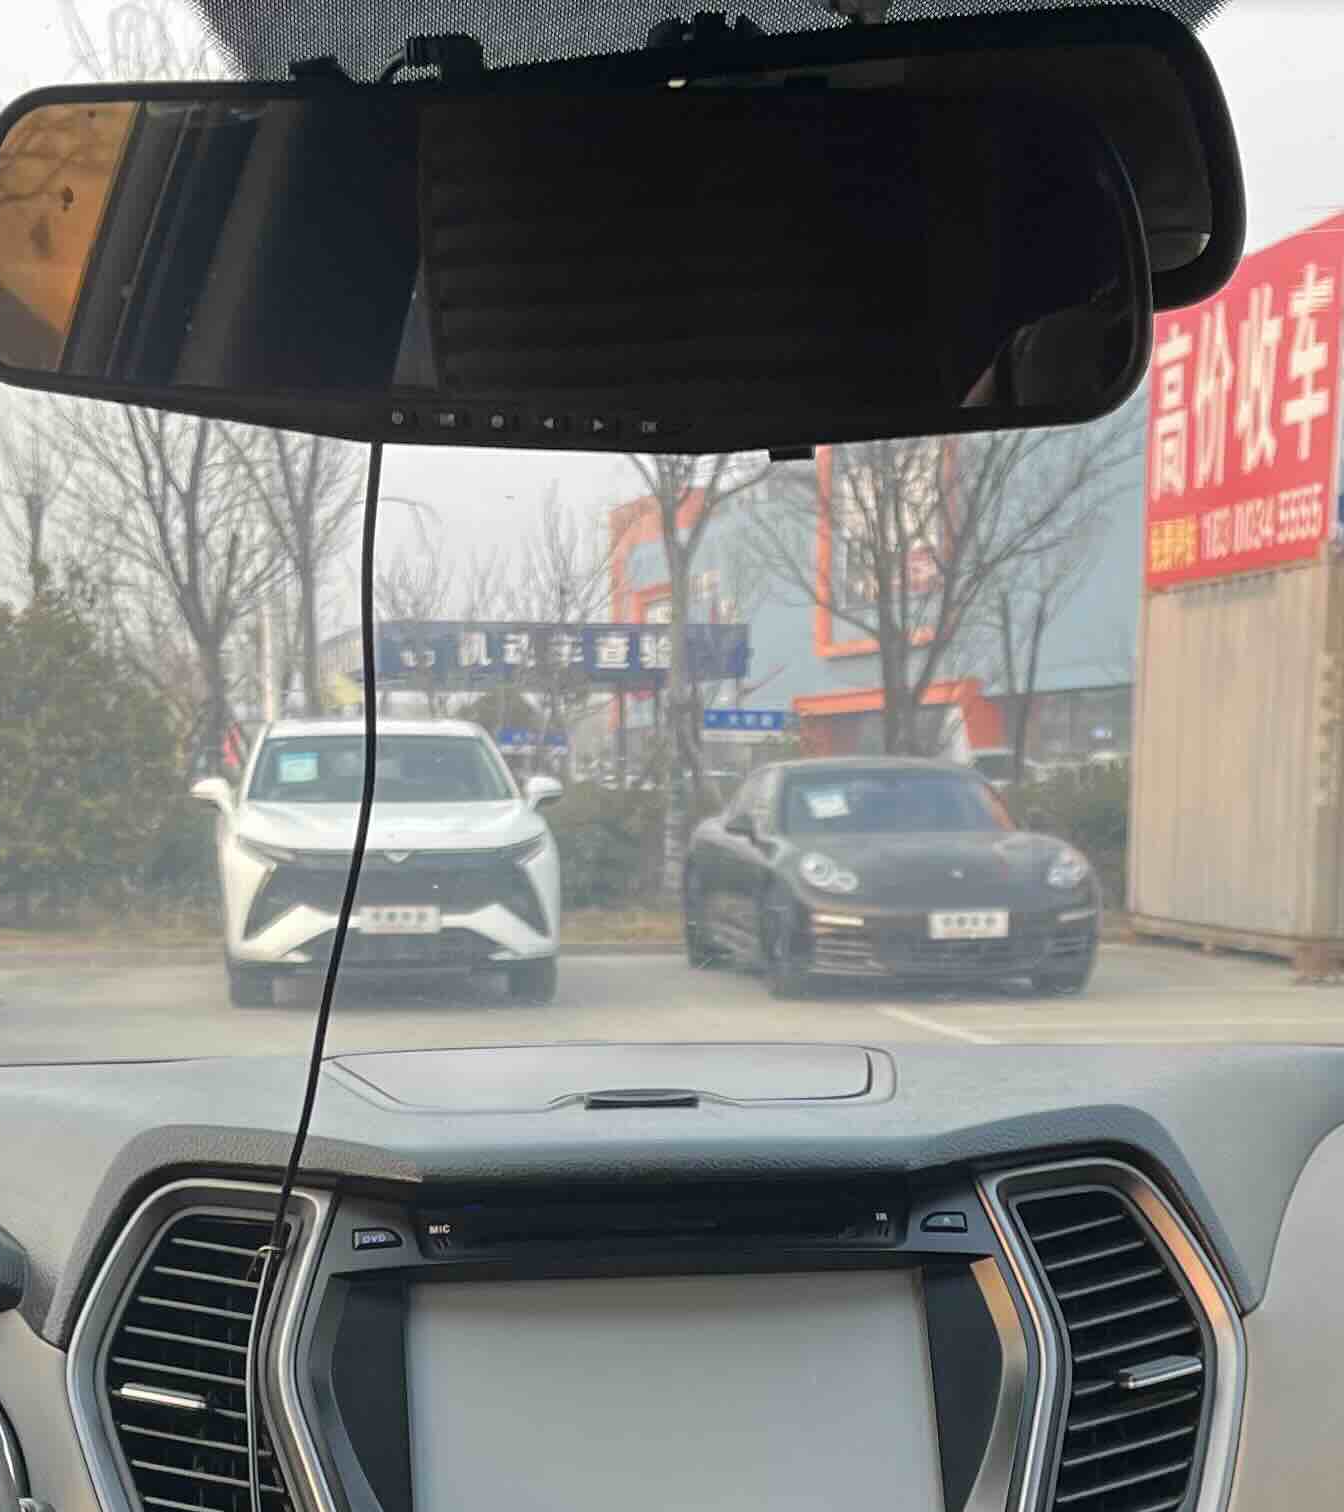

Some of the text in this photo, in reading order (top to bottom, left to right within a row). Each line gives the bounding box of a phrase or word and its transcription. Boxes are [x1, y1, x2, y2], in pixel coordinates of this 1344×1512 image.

[1153, 262, 1336, 502] 高价收车
[429, 1224, 451, 1235] MIC
[362, 1233, 386, 1244] DVD
